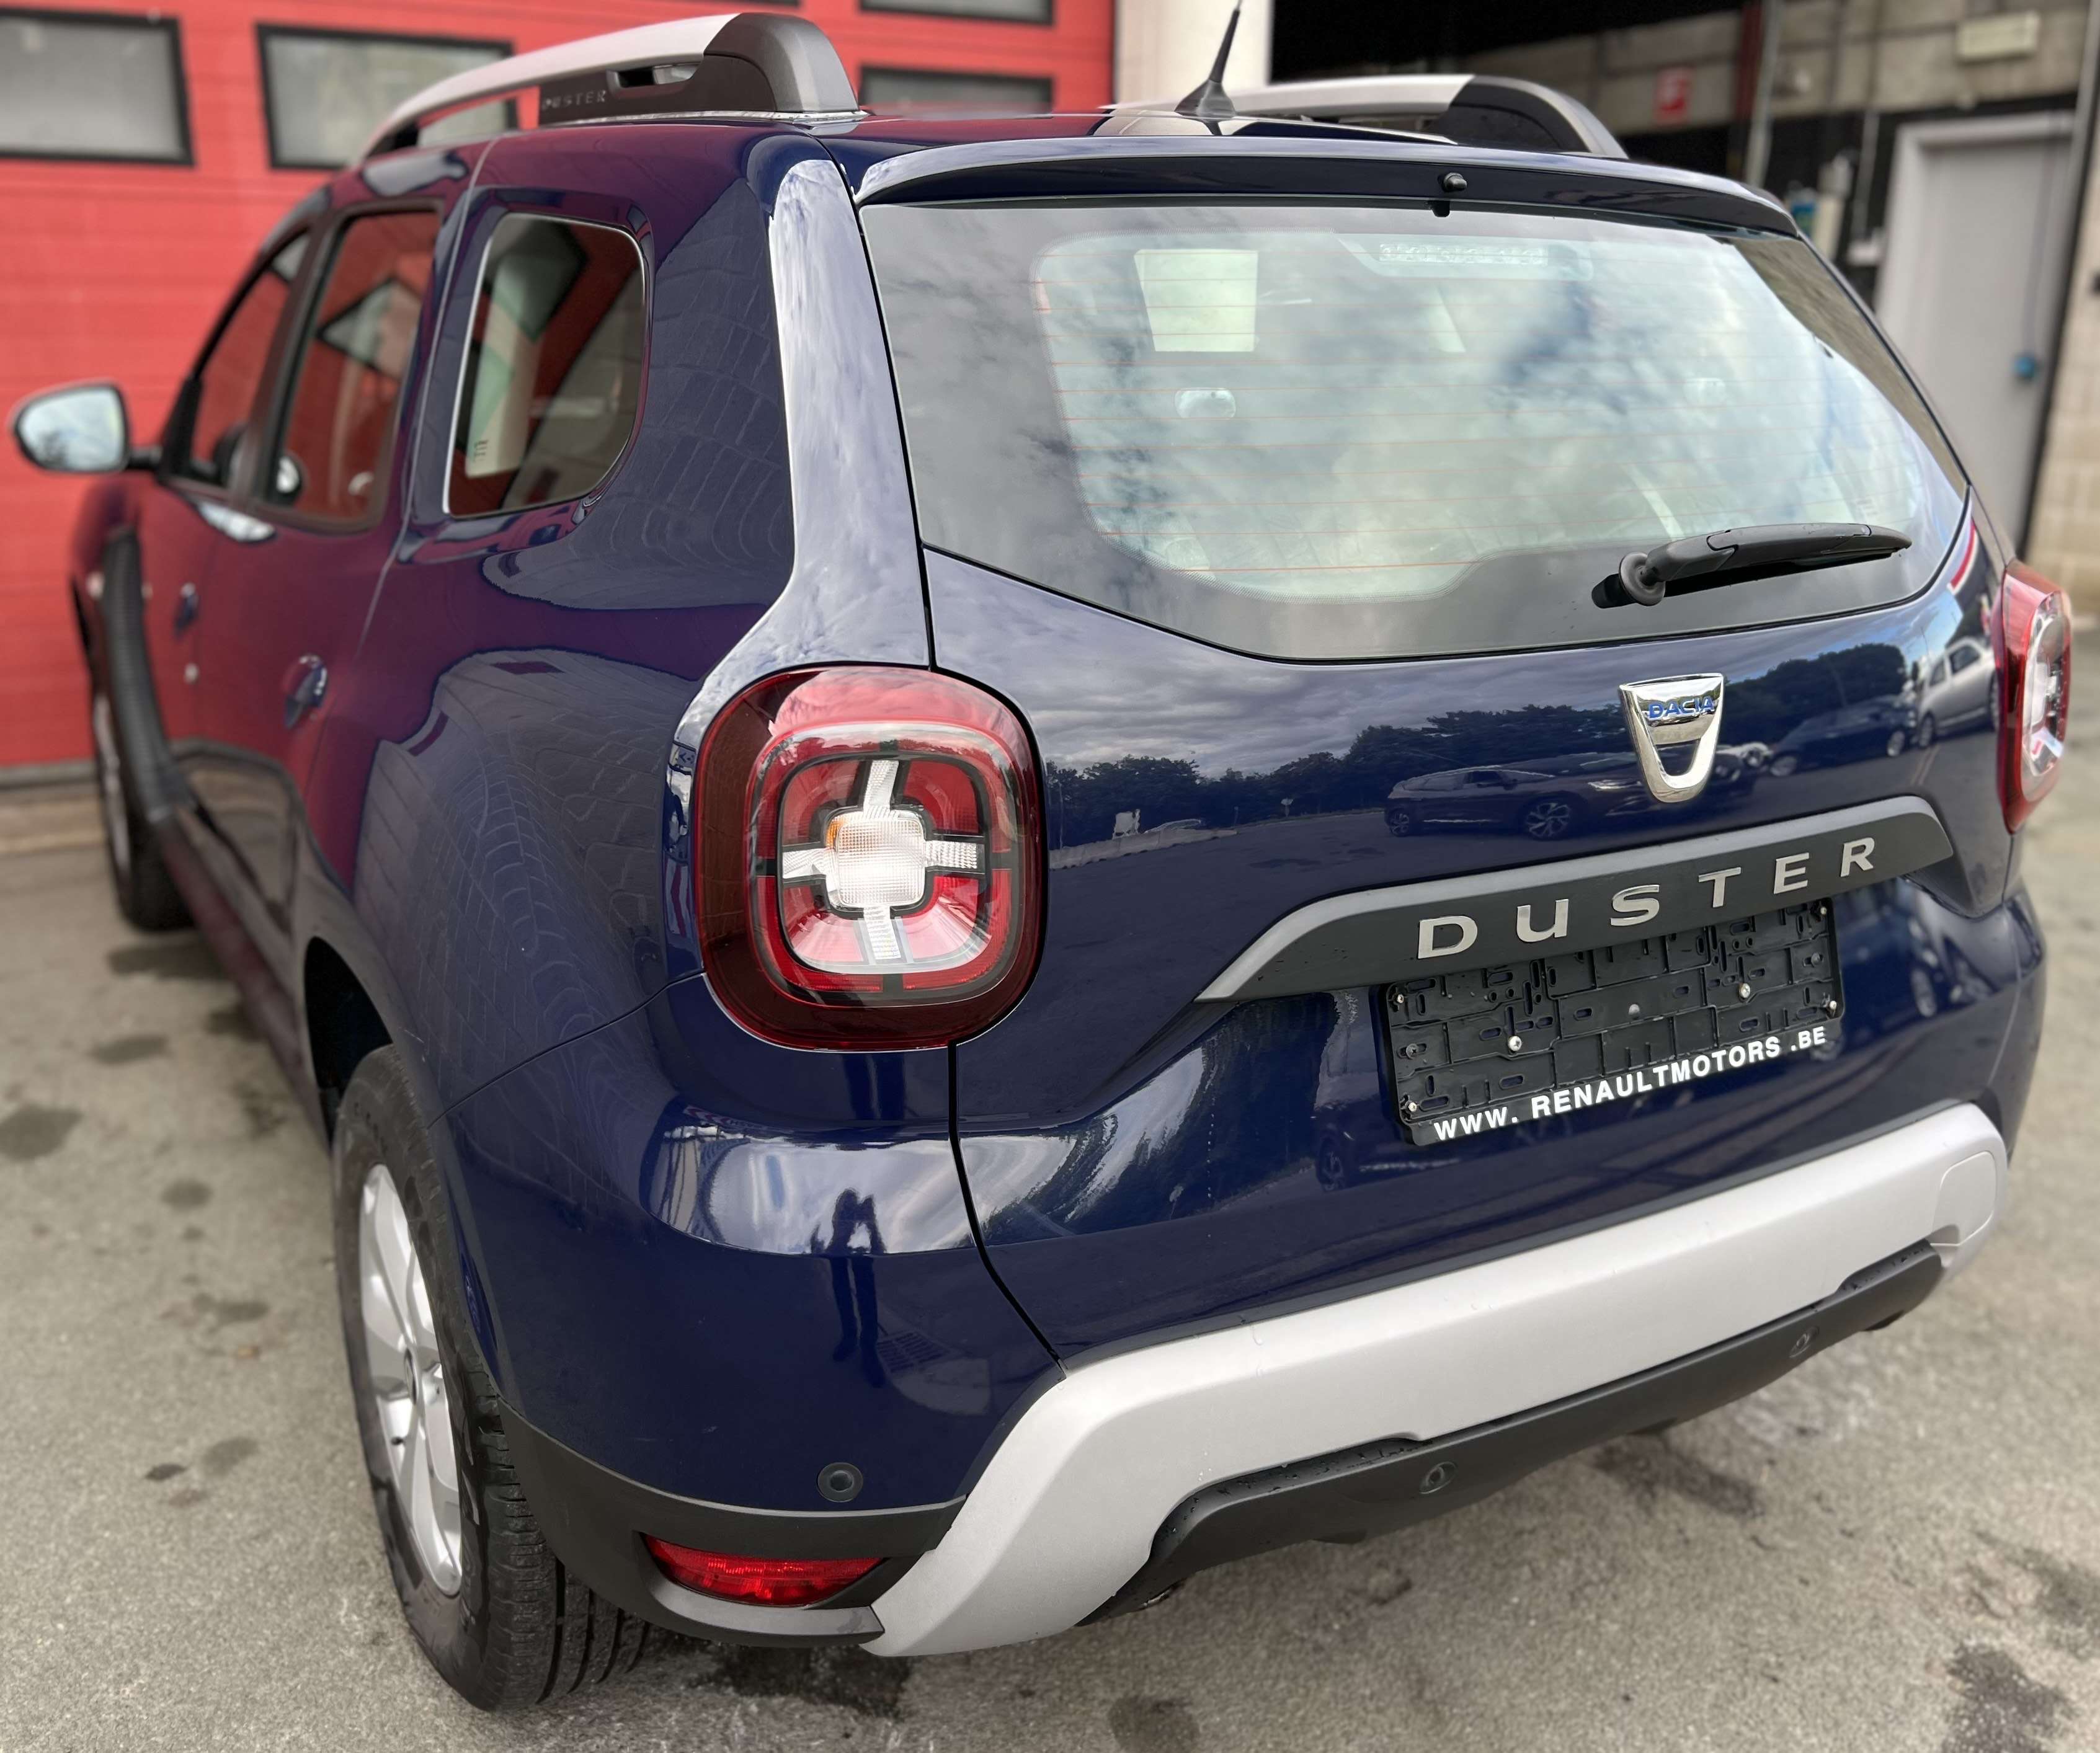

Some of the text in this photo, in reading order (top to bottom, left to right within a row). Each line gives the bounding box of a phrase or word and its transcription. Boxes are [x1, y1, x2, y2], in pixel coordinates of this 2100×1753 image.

[1647, 696, 1715, 721] DACIA
[1417, 837, 1875, 959] DUSTER
[1433, 1106, 1518, 1140] WWW.
[1531, 1036, 1781, 1119] RENAULTMOTORS
